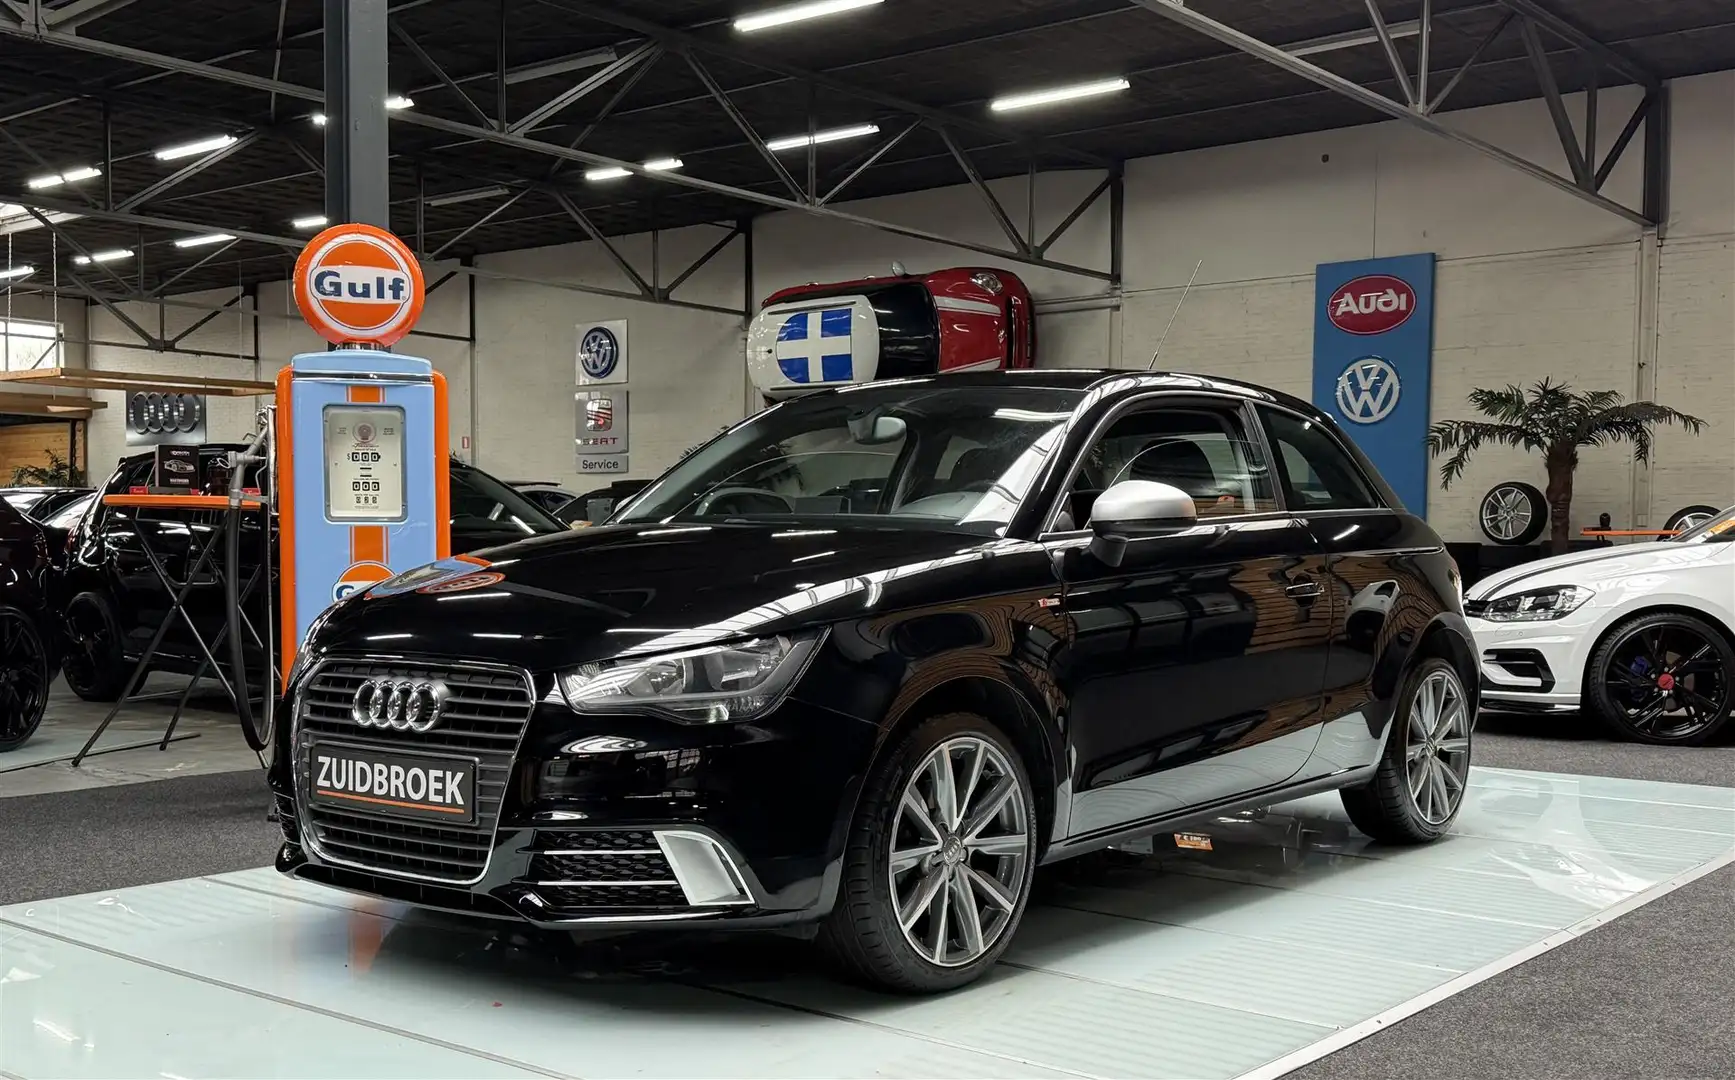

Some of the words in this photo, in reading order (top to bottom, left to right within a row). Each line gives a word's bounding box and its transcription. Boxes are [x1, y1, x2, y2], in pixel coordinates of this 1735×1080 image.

[314, 270, 405, 300] Gulf
[582, 436, 618, 445] SEAT
[582, 459, 619, 470] Service
[317, 756, 464, 805] ZUIDBROEK
